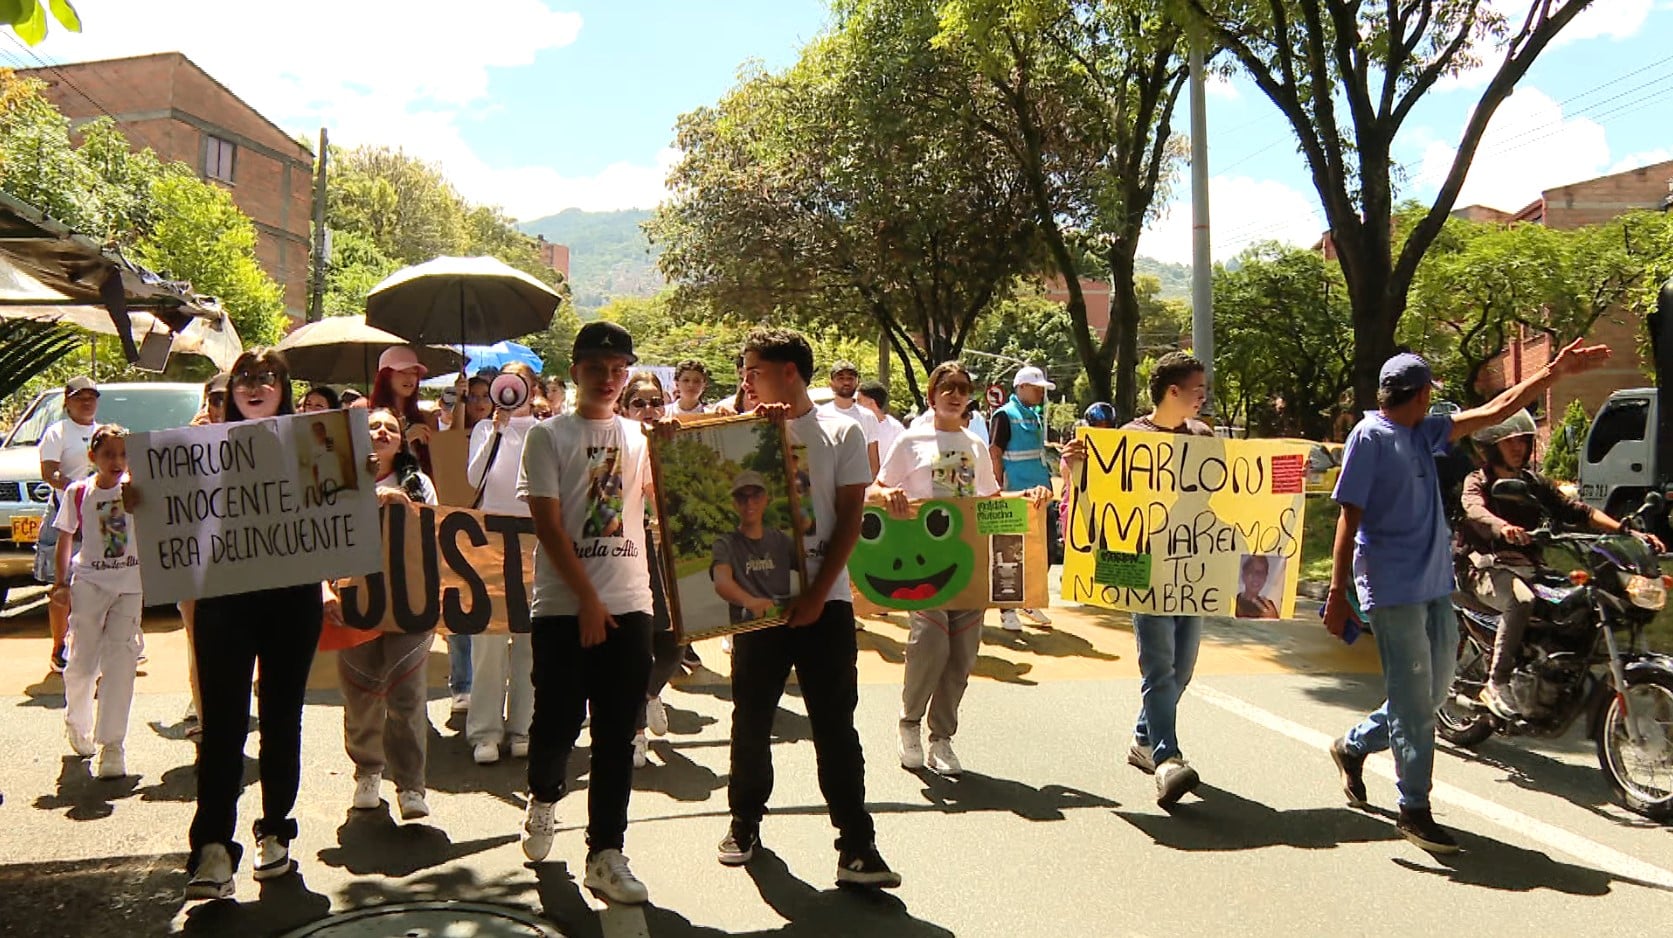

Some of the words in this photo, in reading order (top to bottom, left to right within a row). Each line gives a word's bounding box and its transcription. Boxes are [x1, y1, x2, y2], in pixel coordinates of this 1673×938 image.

[147, 437, 256, 480] MARLON
[1080, 434, 1264, 495] MARLON
[165, 480, 300, 526] INOCENTE,
[305, 478, 338, 508] NO
[158, 536, 201, 570] ERA
[211, 514, 356, 565] DELINCUENTE
[1164, 555, 1206, 587] TU
[1074, 575, 1220, 613] NOMBRE
